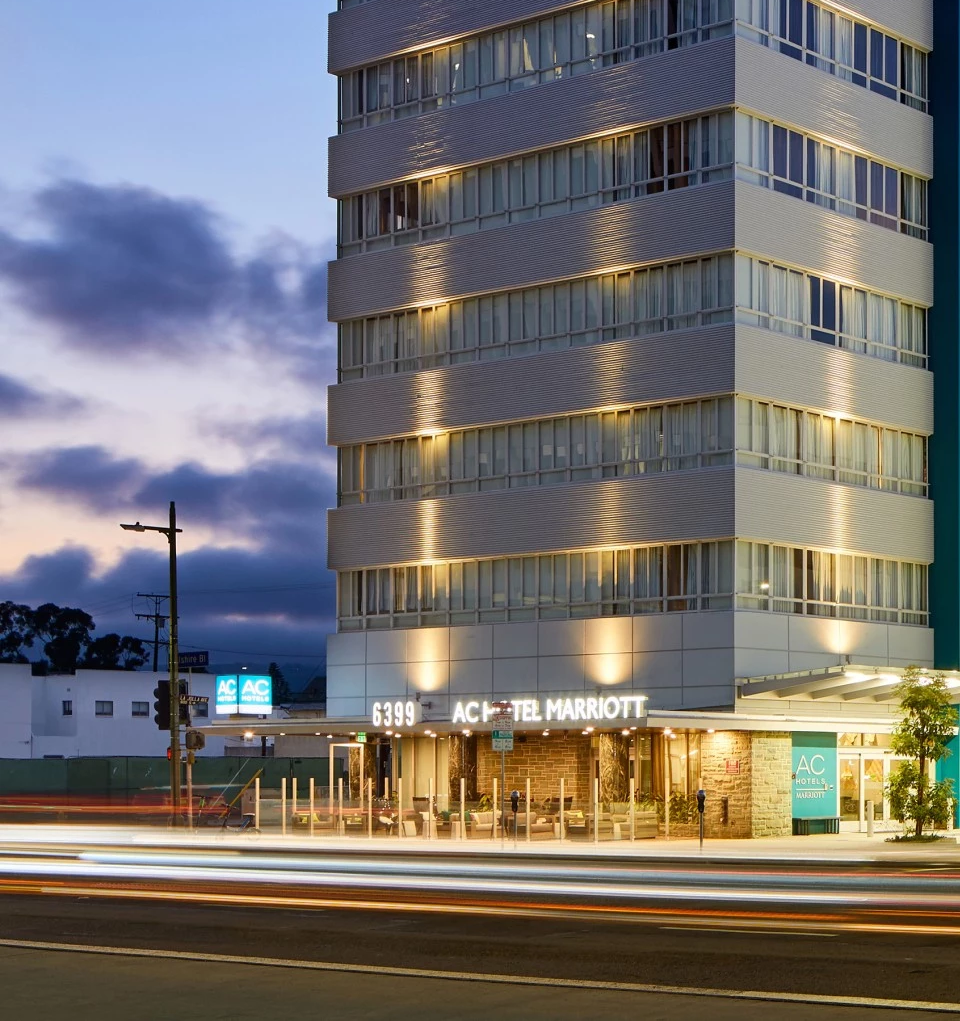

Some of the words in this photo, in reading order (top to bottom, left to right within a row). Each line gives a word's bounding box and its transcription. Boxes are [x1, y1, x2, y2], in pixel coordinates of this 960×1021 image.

[217, 679, 237, 695] AC
[241, 679, 270, 696] AC
[372, 701, 416, 727] 6399
[452, 701, 480, 723] AC
[482, 699, 542, 722] HTEL
[546, 696, 649, 720] MARRIOTT
[796, 754, 825, 775] AC
[796, 791, 826, 799] MARRIOTT
